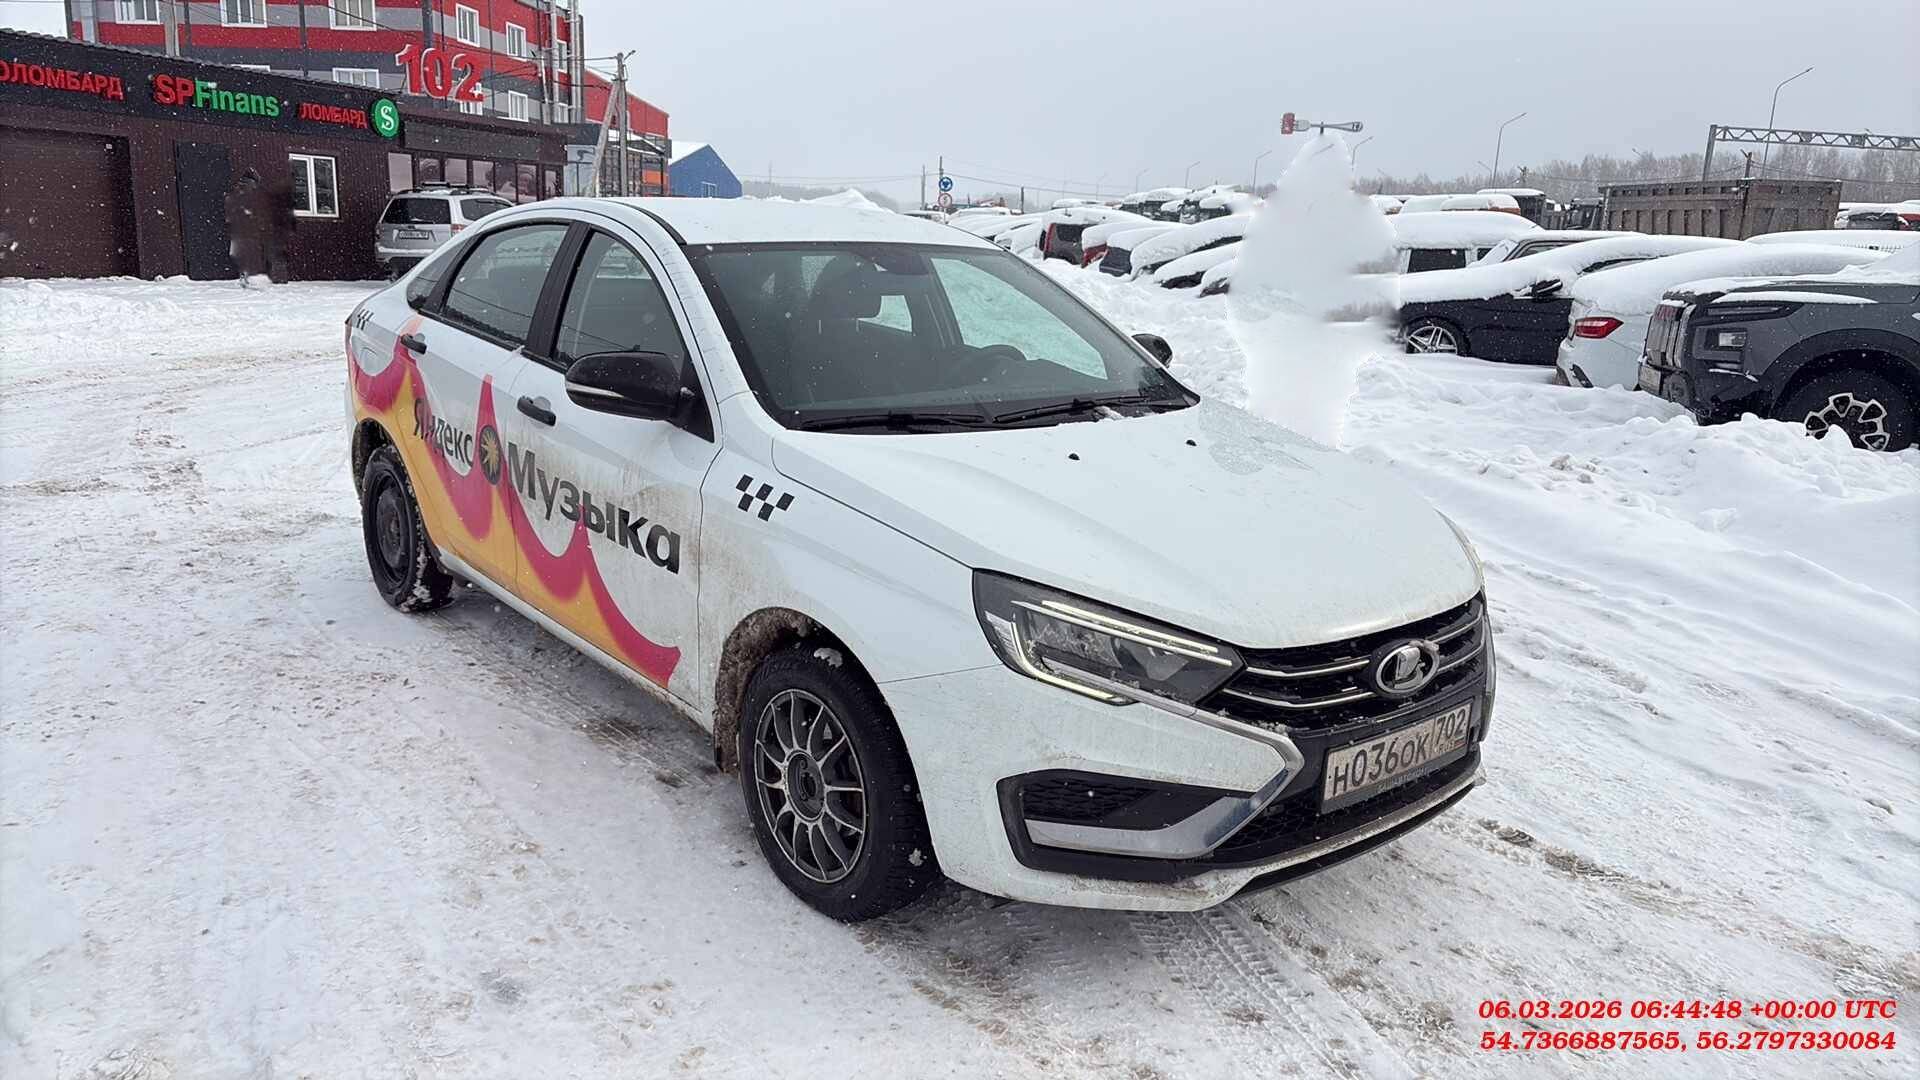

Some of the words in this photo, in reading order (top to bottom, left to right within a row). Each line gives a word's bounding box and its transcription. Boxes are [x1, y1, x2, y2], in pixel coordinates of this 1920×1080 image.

[153, 73, 281, 118] SPFinans
[395, 43, 485, 103] 102
[300, 102, 368, 129] ЛОМБАРД
[413, 397, 474, 468] Яндекс
[507, 441, 681, 575] Музыка
[1435, 708, 1466, 745] 702
